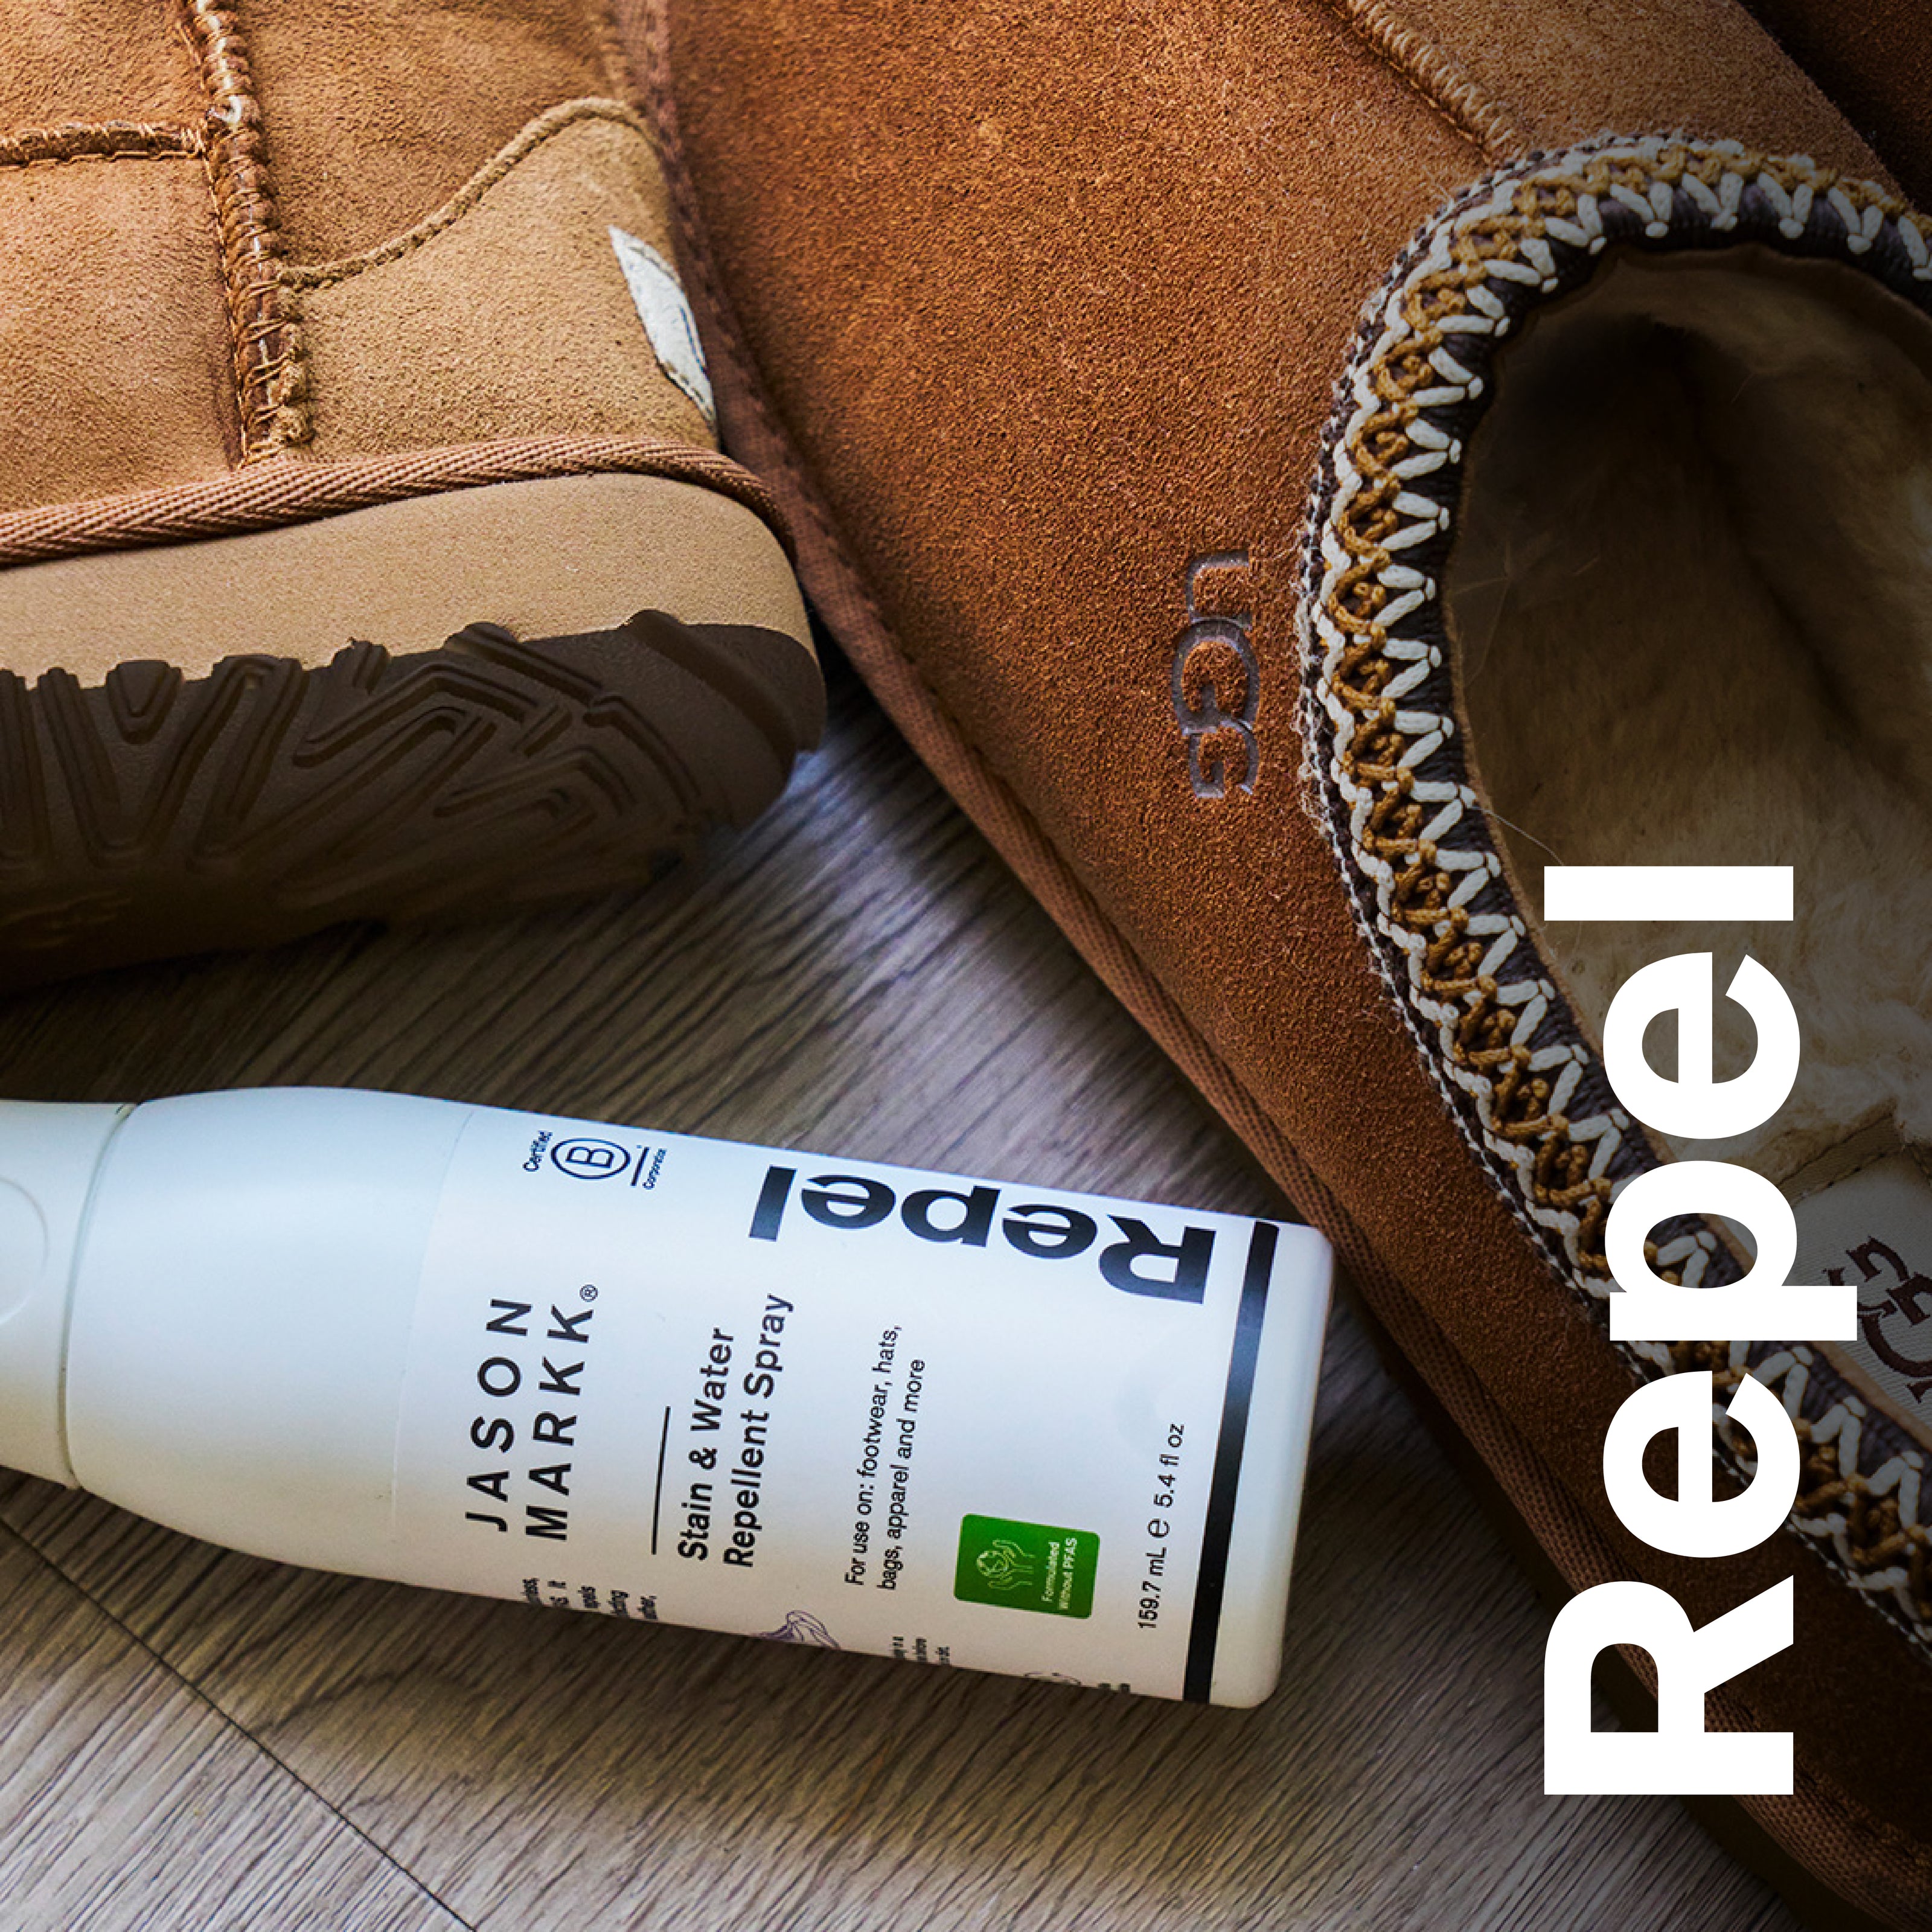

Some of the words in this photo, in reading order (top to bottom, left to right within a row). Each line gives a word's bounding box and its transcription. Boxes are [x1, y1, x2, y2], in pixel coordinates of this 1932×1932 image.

[1172, 551, 1260, 798] UGG
[749, 1165, 1217, 1304] Repel
[744, 1293, 794, 1399] Spray
[871, 1326, 901, 1374] hats,
[690, 1328, 734, 1431] Water
[903, 1360, 925, 1413] more
[465, 1299, 531, 1532] JASON
[857, 1381, 892, 1478] footwear,
[896, 1418, 916, 1460] and
[1168, 1424, 1184, 1448] oz
[688, 1447, 717, 1471] &
[1159, 1454, 1179, 1467] fl
[723, 1409, 769, 1567] Repellent
[857, 1483, 875, 1515] on:
[888, 1465, 909, 1540] apparel
[1154, 1474, 1176, 1508] 5.4
[677, 1483, 712, 1561] Stain
[853, 1521, 869, 1555] use
[845, 1556, 866, 1585] For
[877, 1546, 904, 1590] bags,
[1063, 1538, 1077, 1569] PFAS
[1145, 1547, 1166, 1576] mL
[1137, 1581, 1161, 1628] 159.7
